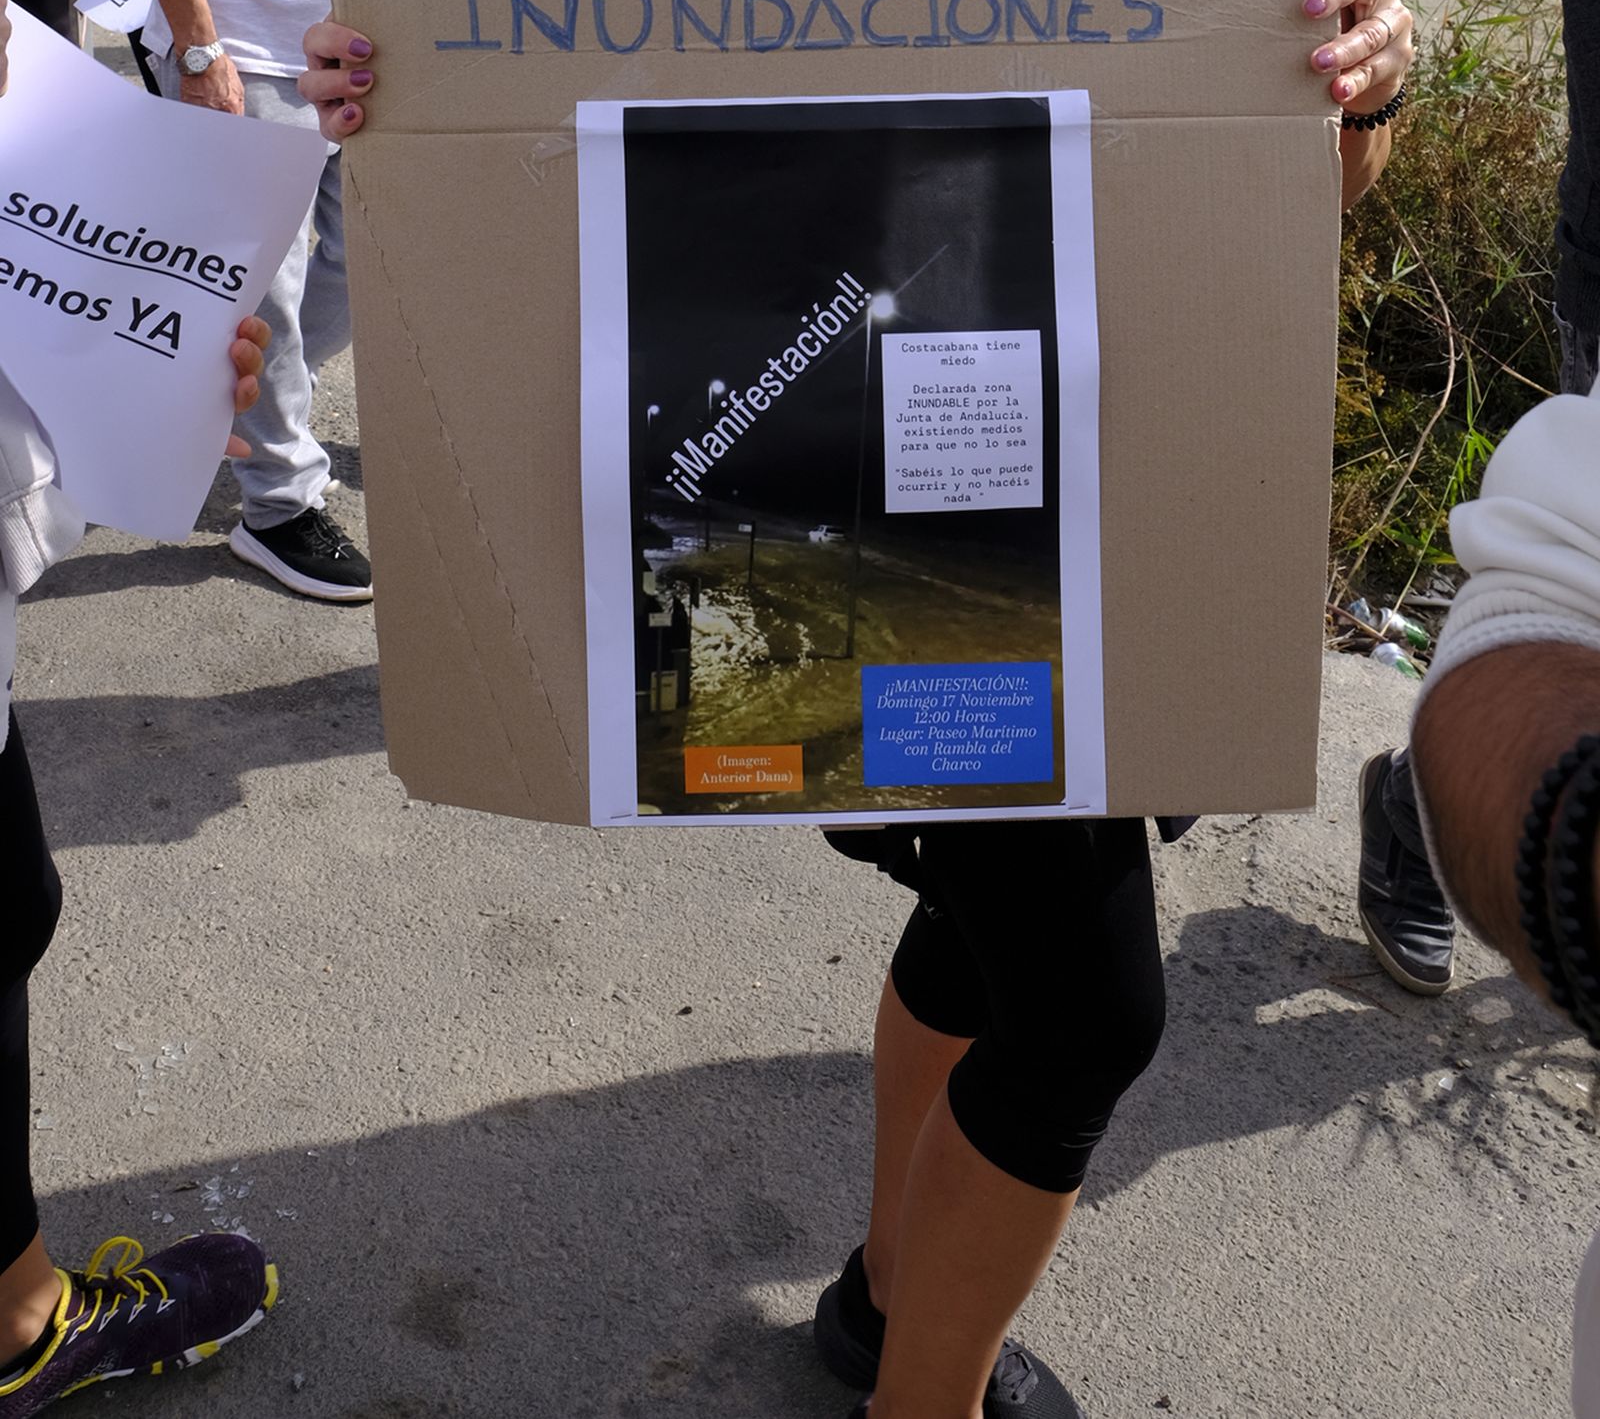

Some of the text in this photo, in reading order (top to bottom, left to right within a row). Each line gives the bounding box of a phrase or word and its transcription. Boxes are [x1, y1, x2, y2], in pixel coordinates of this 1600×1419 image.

[3, 191, 248, 293] soluciones
[127, 296, 182, 351] YA
[901, 340, 1021, 353] Costacabana tiene
[940, 355, 976, 366] miedo
[912, 383, 1012, 395] Declarada zona
[907, 396, 1019, 409] INUNDABLE por la
[895, 413, 932, 423] Junta
[939, 412, 953, 422] de
[904, 424, 1023, 437] existiendo medios
[901, 438, 1027, 453] para que no lo sea
[950, 466, 964, 477] lo
[971, 466, 992, 477] que
[999, 463, 1034, 476] puede
[897, 477, 1030, 492] ocurrir y no hacéis
[877, 692, 1035, 710] Domingo 17 Noviembre
[914, 709, 997, 724] 12:00 Horas
[879, 725, 1037, 744] Lugar: Paseo Marítimo
[904, 740, 1013, 757] con Rambla del
[717, 754, 772, 769] (Imagen:
[931, 757, 982, 772] Charco
[700, 769, 793, 784] Anterior Dana)
